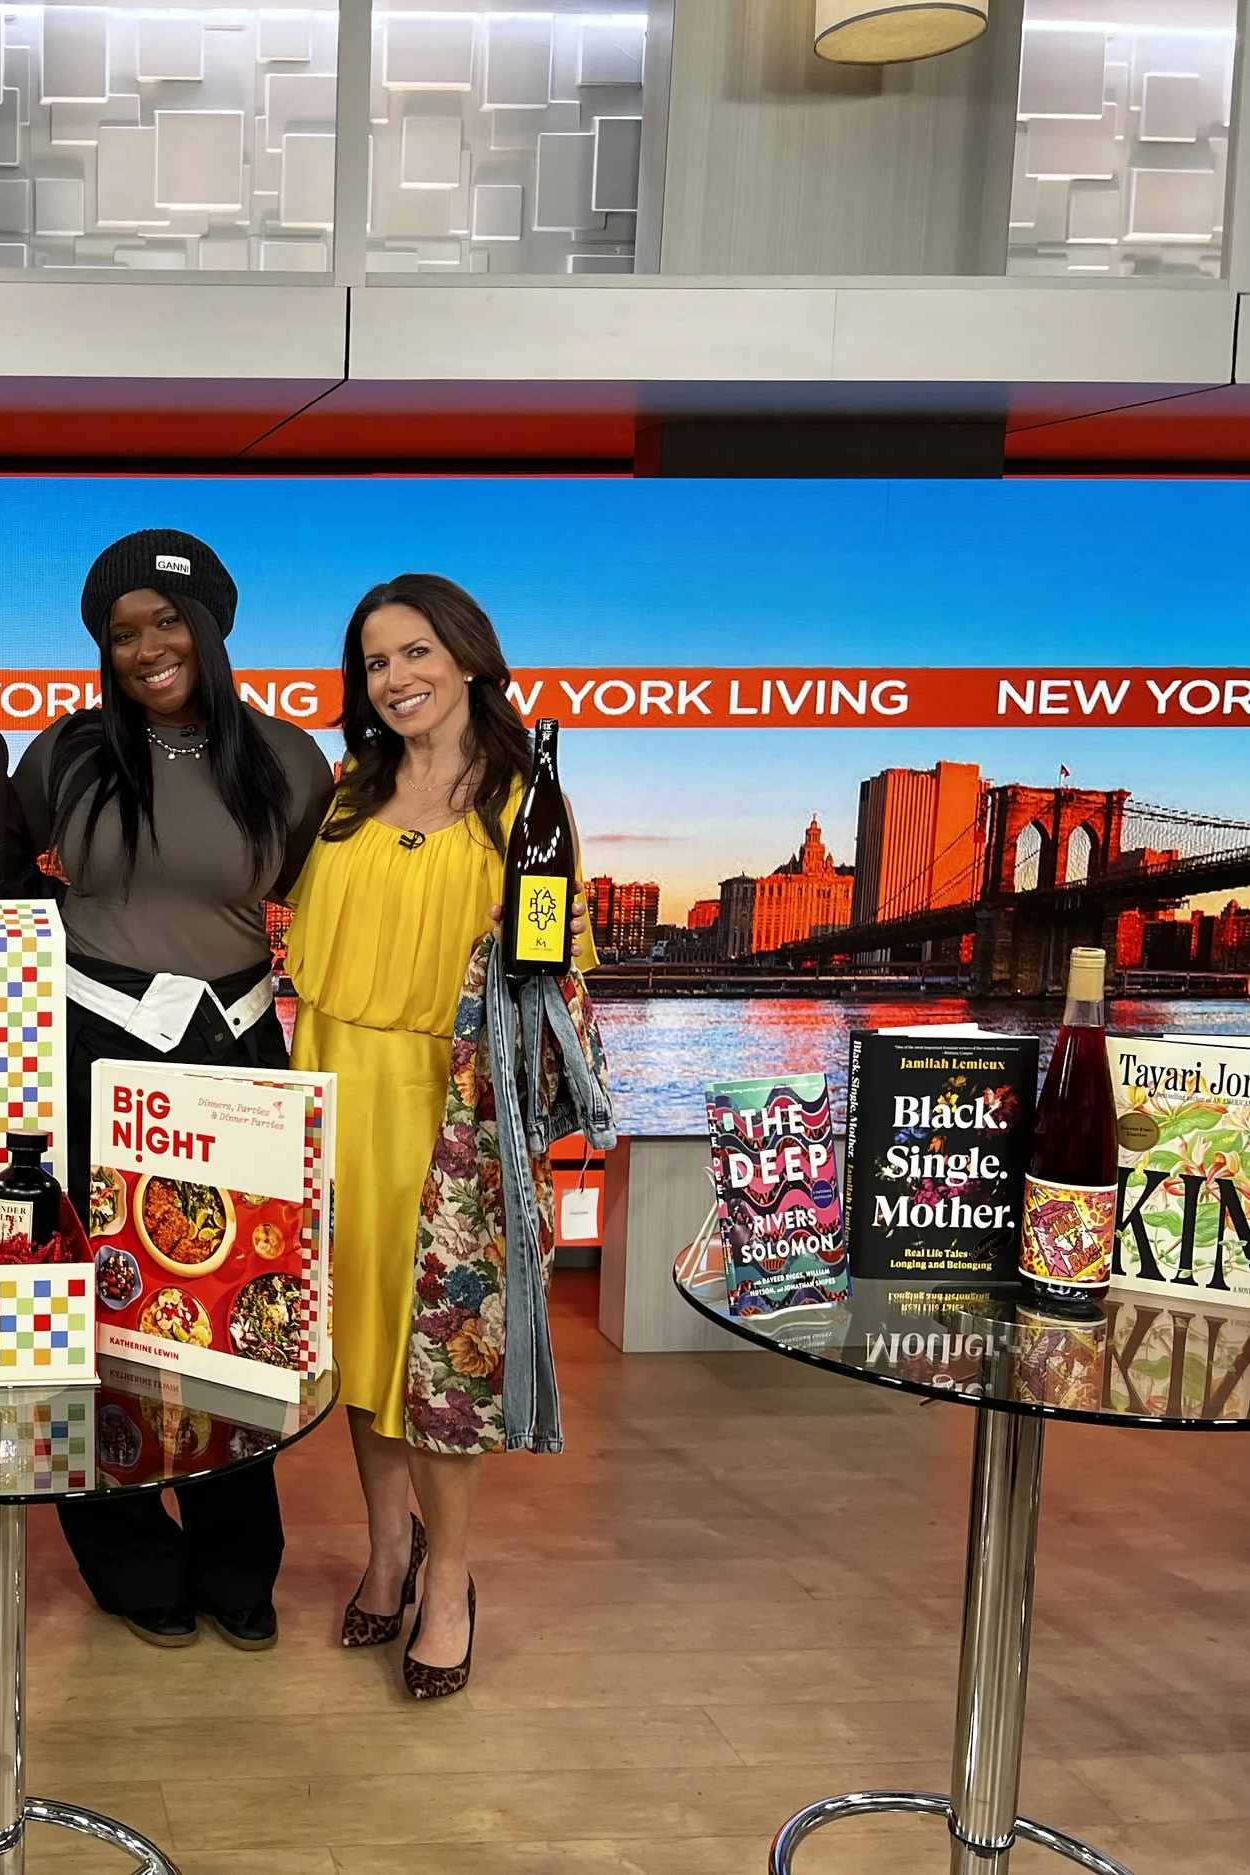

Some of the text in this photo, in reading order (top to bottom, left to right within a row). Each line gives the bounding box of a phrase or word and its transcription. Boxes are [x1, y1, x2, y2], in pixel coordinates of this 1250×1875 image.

[157, 560, 189, 573] GANNI
[558, 680, 713, 716] YORK
[729, 680, 909, 716] LIVING
[997, 679, 1131, 715] NEW
[900, 1057, 1006, 1070] Jamilah Lemieux
[1119, 1053, 1202, 1098] Tayari
[197, 1097, 271, 1116] Dinners, Parties
[892, 1095, 1007, 1129] Black.
[211, 1112, 285, 1131] & Dinner Parties
[739, 1103, 805, 1139] THE
[728, 1143, 828, 1189] DEEP
[886, 1145, 1008, 1187] Single.
[753, 1207, 818, 1234] RIVERS
[871, 1195, 1015, 1229] Mother.
[740, 1233, 835, 1264] SOLOMON
[904, 1248, 968, 1258] Real Life Tales
[806, 1268, 831, 1278] WILLIAM
[890, 1260, 992, 1271] Longing and Belonging
[784, 1281, 815, 1292] JONATHAN
[816, 1277, 836, 1286] SNIPES
[110, 1337, 179, 1360] KATHERINE LEWIN
